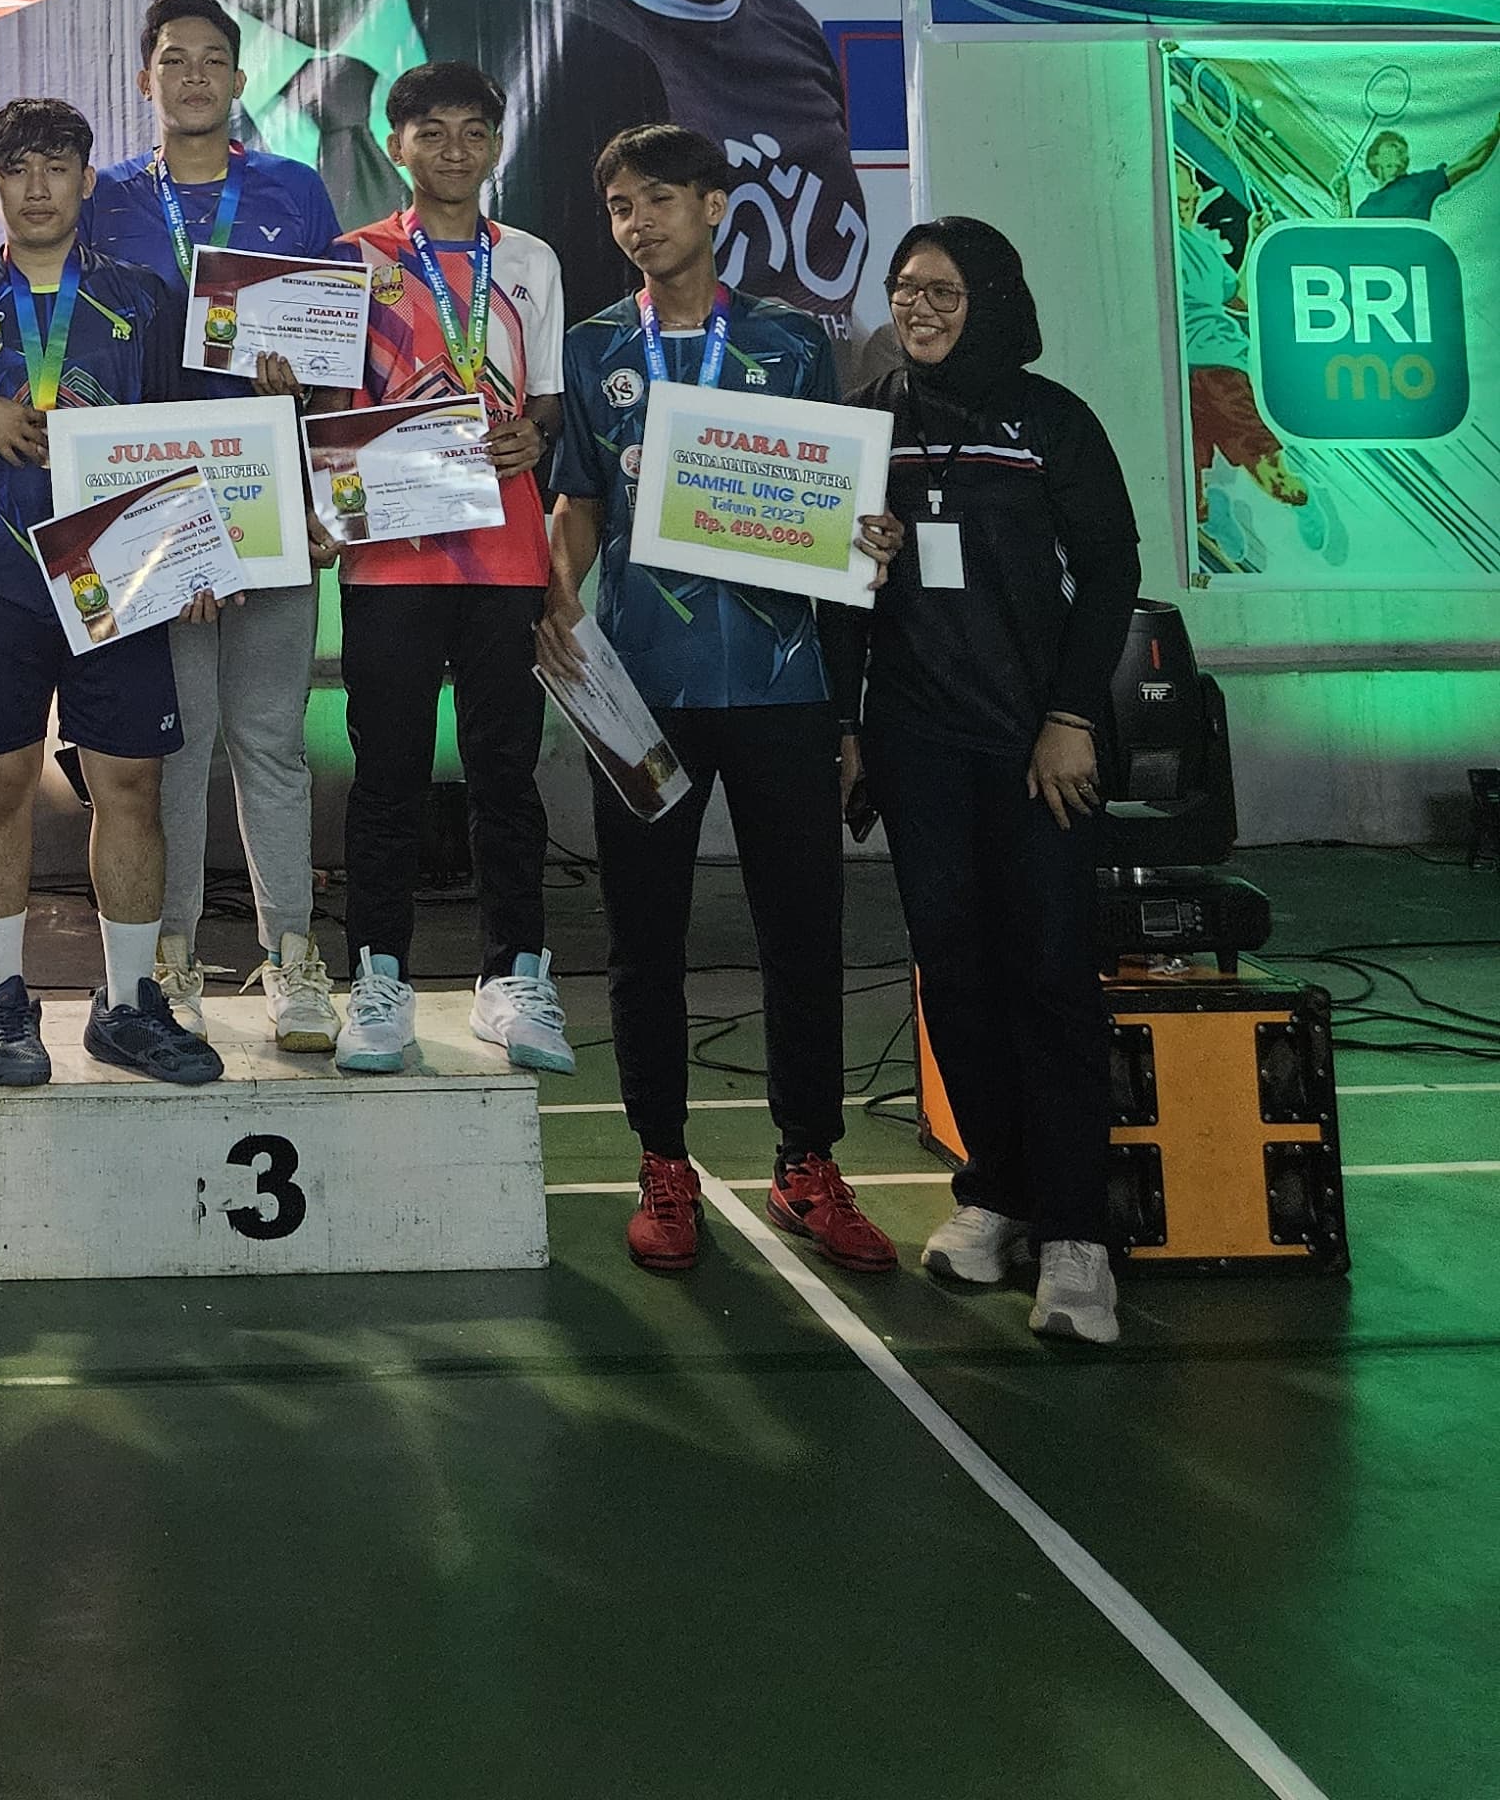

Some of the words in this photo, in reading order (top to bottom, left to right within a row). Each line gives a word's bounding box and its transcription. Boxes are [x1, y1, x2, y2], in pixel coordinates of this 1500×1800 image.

[421, 251, 434, 272] CUP
[429, 273, 442, 299] UNG
[306, 307, 343, 318] JUARA
[344, 310, 360, 320] III
[1291, 264, 1432, 344] BRI
[439, 299, 457, 340] DAMHIL
[645, 328, 655, 349] CUP
[745, 373, 767, 386] RS
[1324, 353, 1436, 400] mo
[108, 440, 205, 464] JUARA
[210, 437, 243, 458] III
[697, 427, 790, 458] JUARA
[797, 441, 831, 464] III
[85, 471, 135, 488] GANDA
[220, 463, 271, 479] PUTRA
[673, 449, 722, 469] GANDA
[721, 456, 802, 482] MAHASISWA
[802, 469, 852, 490] PUTRA
[222, 484, 263, 501] CUP
[677, 470, 747, 495] DAMHIL
[752, 481, 795, 502] UNG
[801, 491, 842, 510] CUP
[198, 513, 213, 525] III
[710, 495, 756, 517] Tahun
[760, 504, 805, 525] 2025
[693, 510, 726, 535] Rp.
[729, 519, 814, 548] 450.000
[1140, 688, 1169, 700] TRF
[224, 1133, 306, 1240] 3
